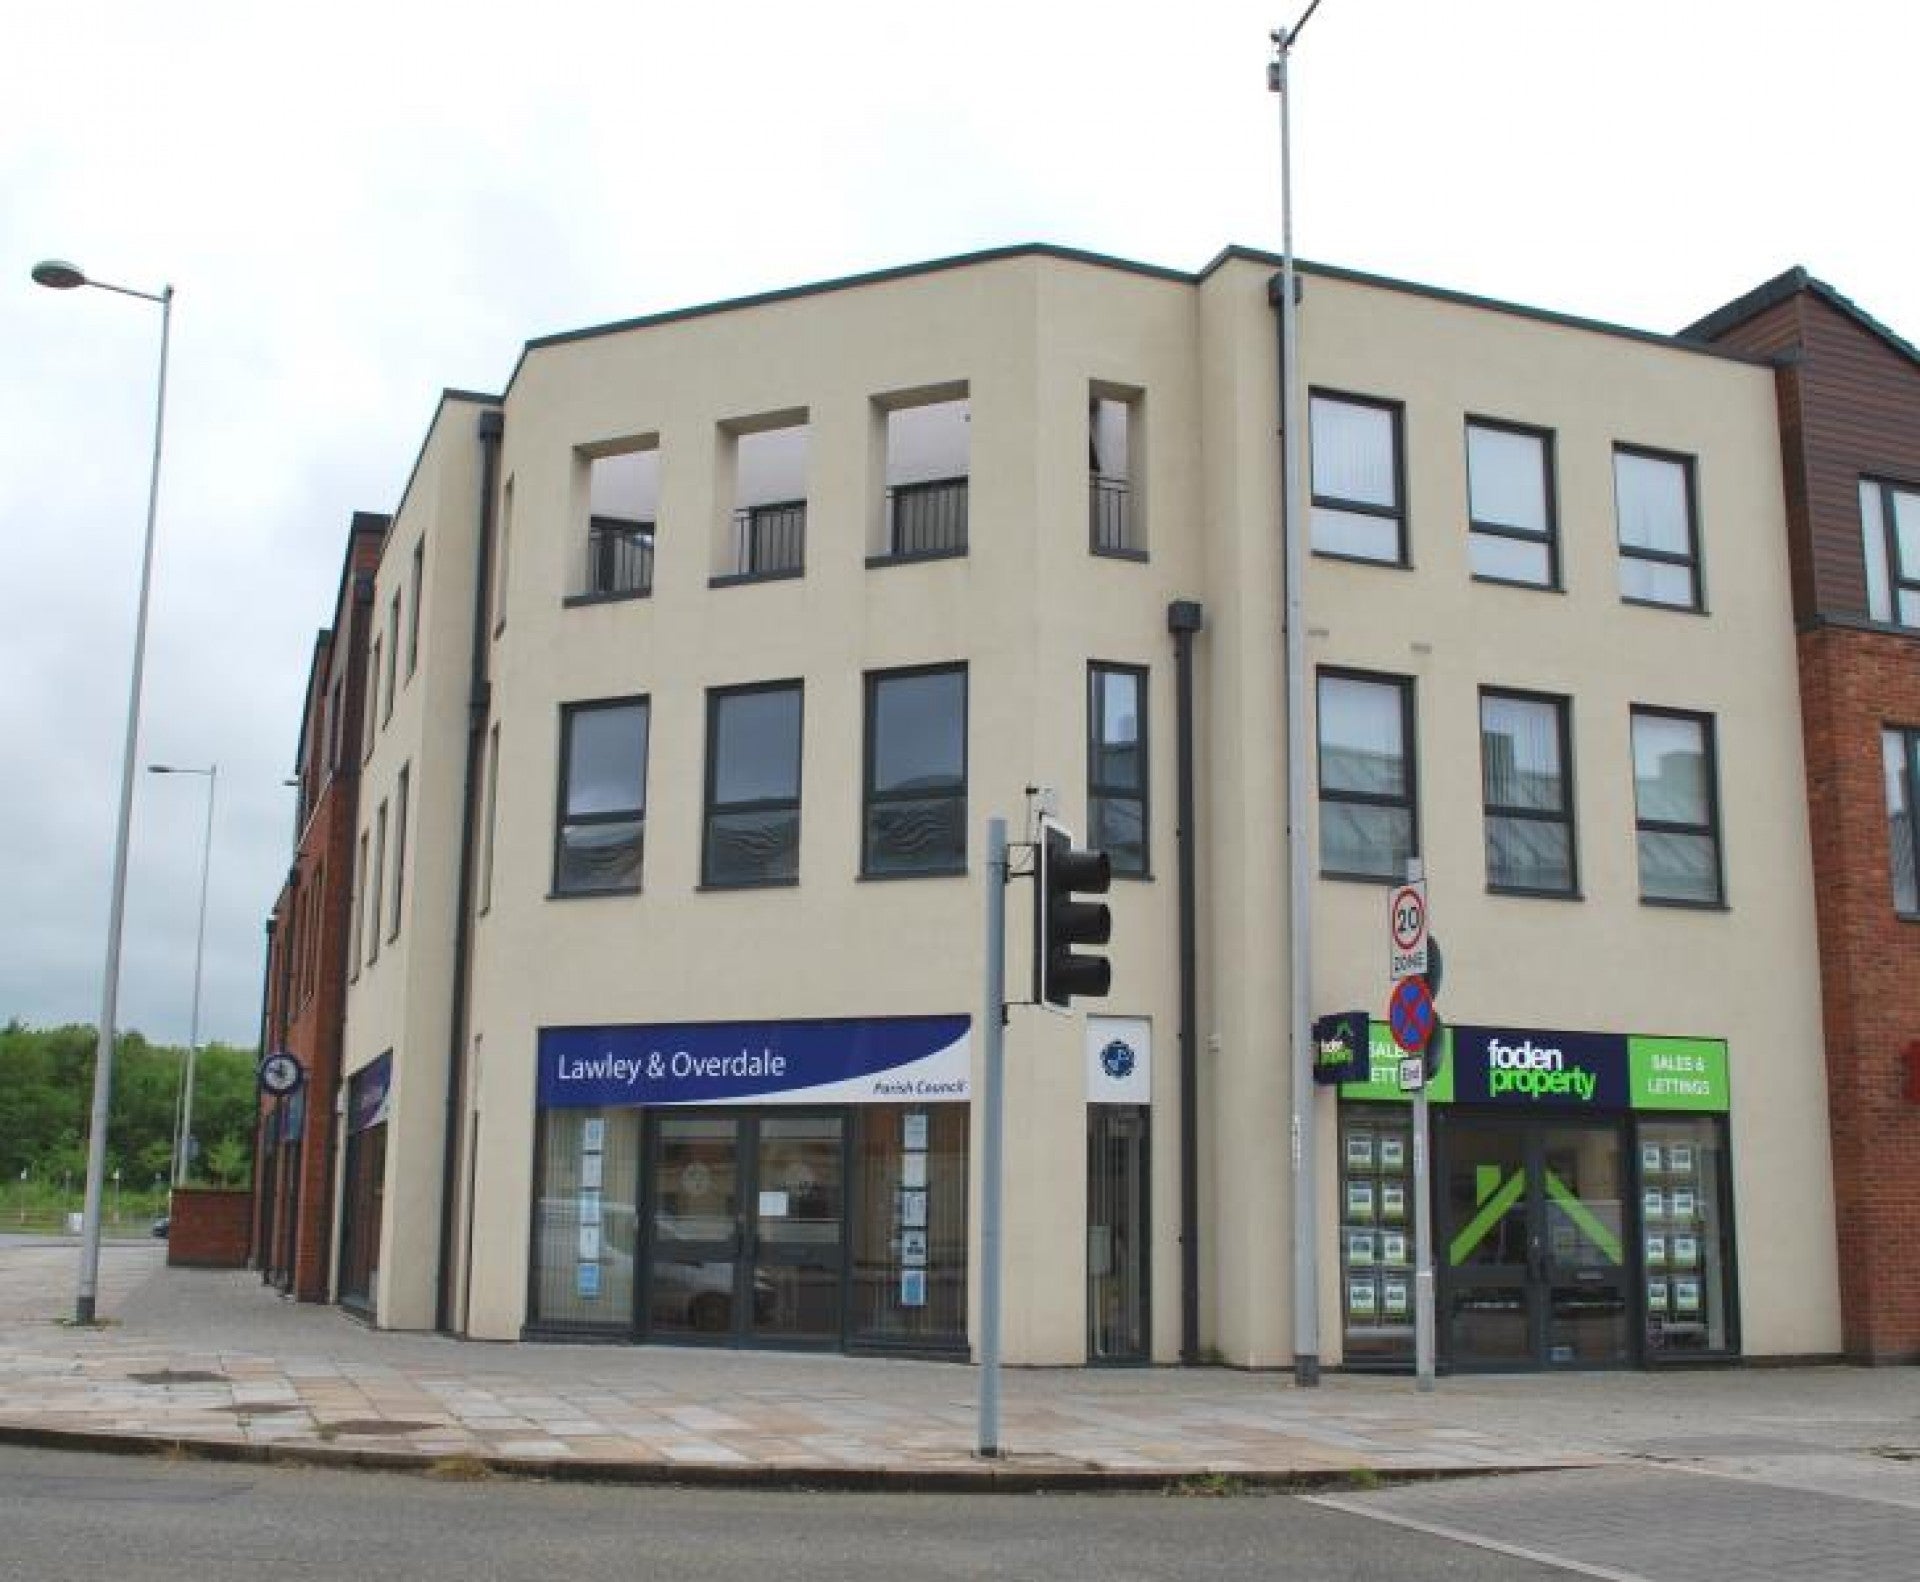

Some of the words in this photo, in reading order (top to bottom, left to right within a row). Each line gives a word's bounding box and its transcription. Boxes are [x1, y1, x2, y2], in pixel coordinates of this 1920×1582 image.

[1398, 906, 1419, 931] 20
[1395, 952, 1424, 973] ZONE
[1487, 1038, 1563, 1071] foden
[1651, 1054, 1692, 1072] SALES
[558, 1051, 642, 1085] Lawley
[648, 1051, 665, 1077] &
[671, 1048, 787, 1077] Overdale
[873, 1080, 913, 1095] Parish
[1489, 1065, 1597, 1101] property
[1647, 1077, 1710, 1096] LETTINGS
